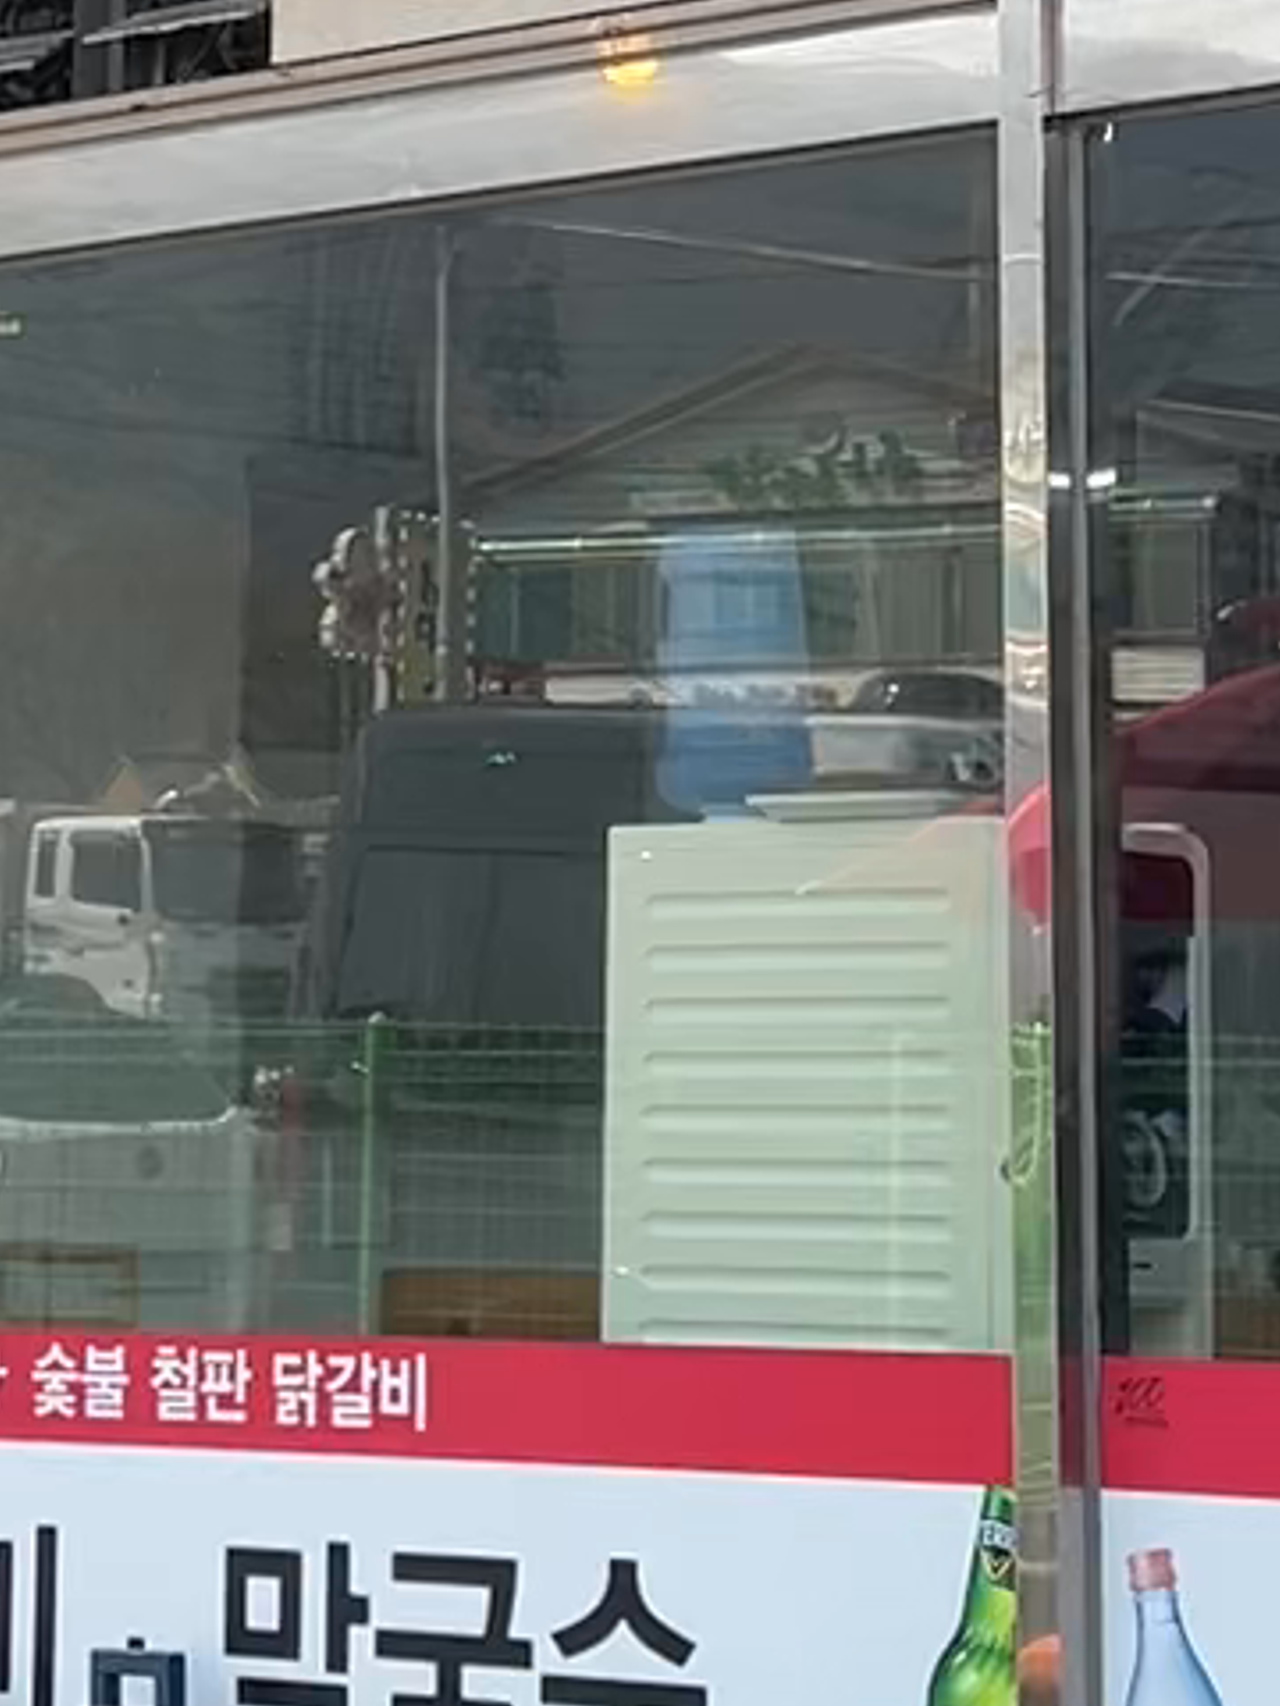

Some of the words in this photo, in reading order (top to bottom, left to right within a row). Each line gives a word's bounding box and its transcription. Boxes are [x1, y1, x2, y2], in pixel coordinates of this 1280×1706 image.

[30, 1341, 131, 1419] 숯불
[150, 1344, 253, 1423] 철판
[271, 1350, 428, 1432] 닭갈비
